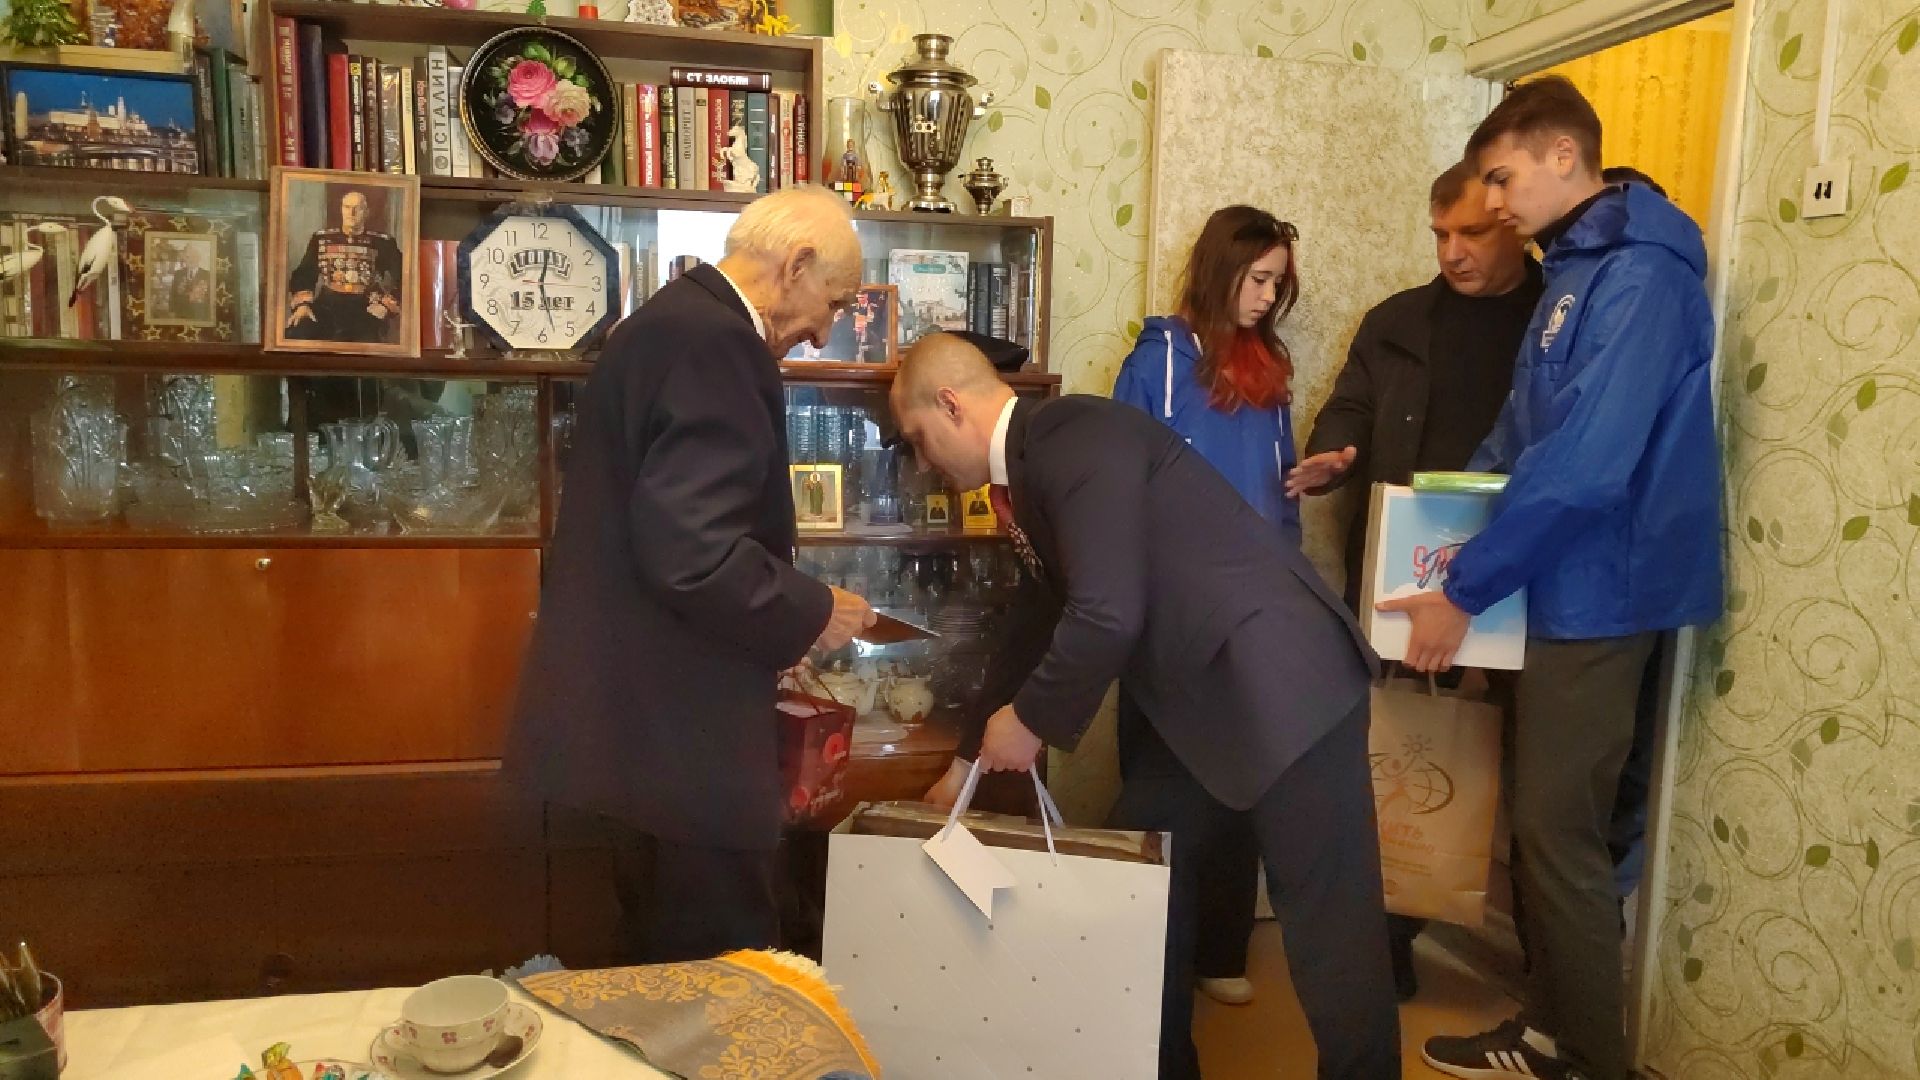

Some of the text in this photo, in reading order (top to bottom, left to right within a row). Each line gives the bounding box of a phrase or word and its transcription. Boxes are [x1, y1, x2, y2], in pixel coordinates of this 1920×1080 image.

[432, 60, 447, 144] СТАЛИН
[682, 110, 692, 160] ФАВОРИТ
[505, 231, 517, 246] 11
[532, 223, 548, 240] 12
[567, 231, 572, 247] 1
[487, 249, 504, 264] 10
[583, 250, 595, 266] 2
[480, 274, 489, 289] 9
[592, 276, 600, 291] 3
[487, 299, 498, 315] 8
[510, 291, 575, 311] 15 лет
[585, 300, 596, 316] 4
[511, 321, 520, 336] 7
[538, 328, 547, 343] 6
[565, 322, 575, 337] 5
